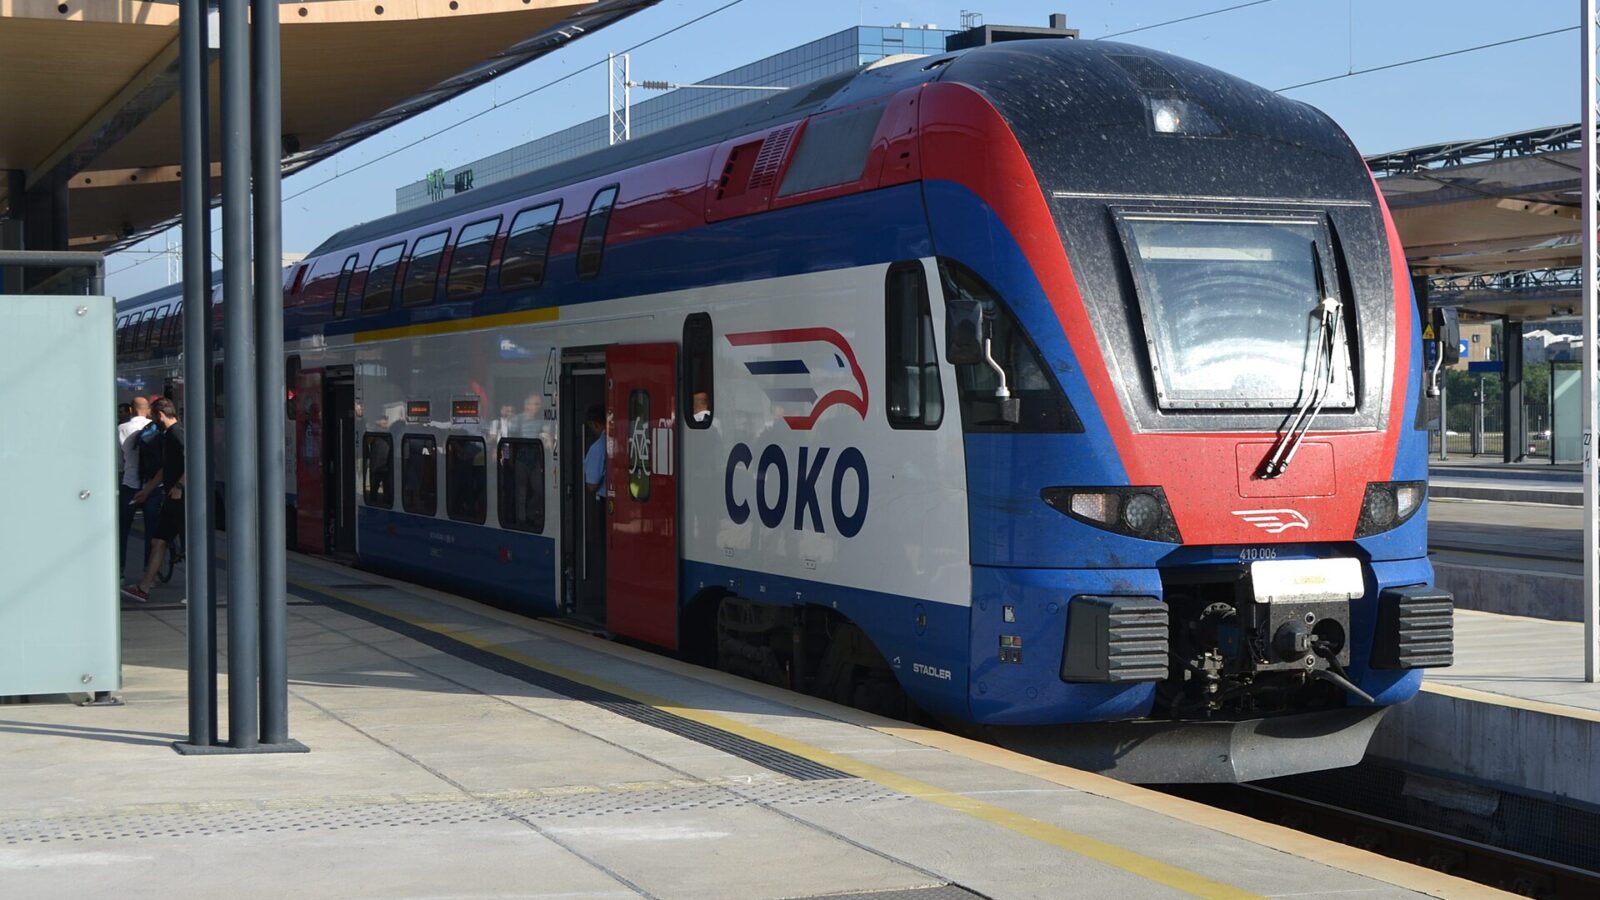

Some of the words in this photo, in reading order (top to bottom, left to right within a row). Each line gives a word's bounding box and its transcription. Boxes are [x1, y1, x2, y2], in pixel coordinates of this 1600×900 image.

[544, 347, 558, 407] 4
[1240, 548, 1257, 560] 410
[1259, 548, 1277, 560] 006
[913, 663, 952, 681] STADLER
